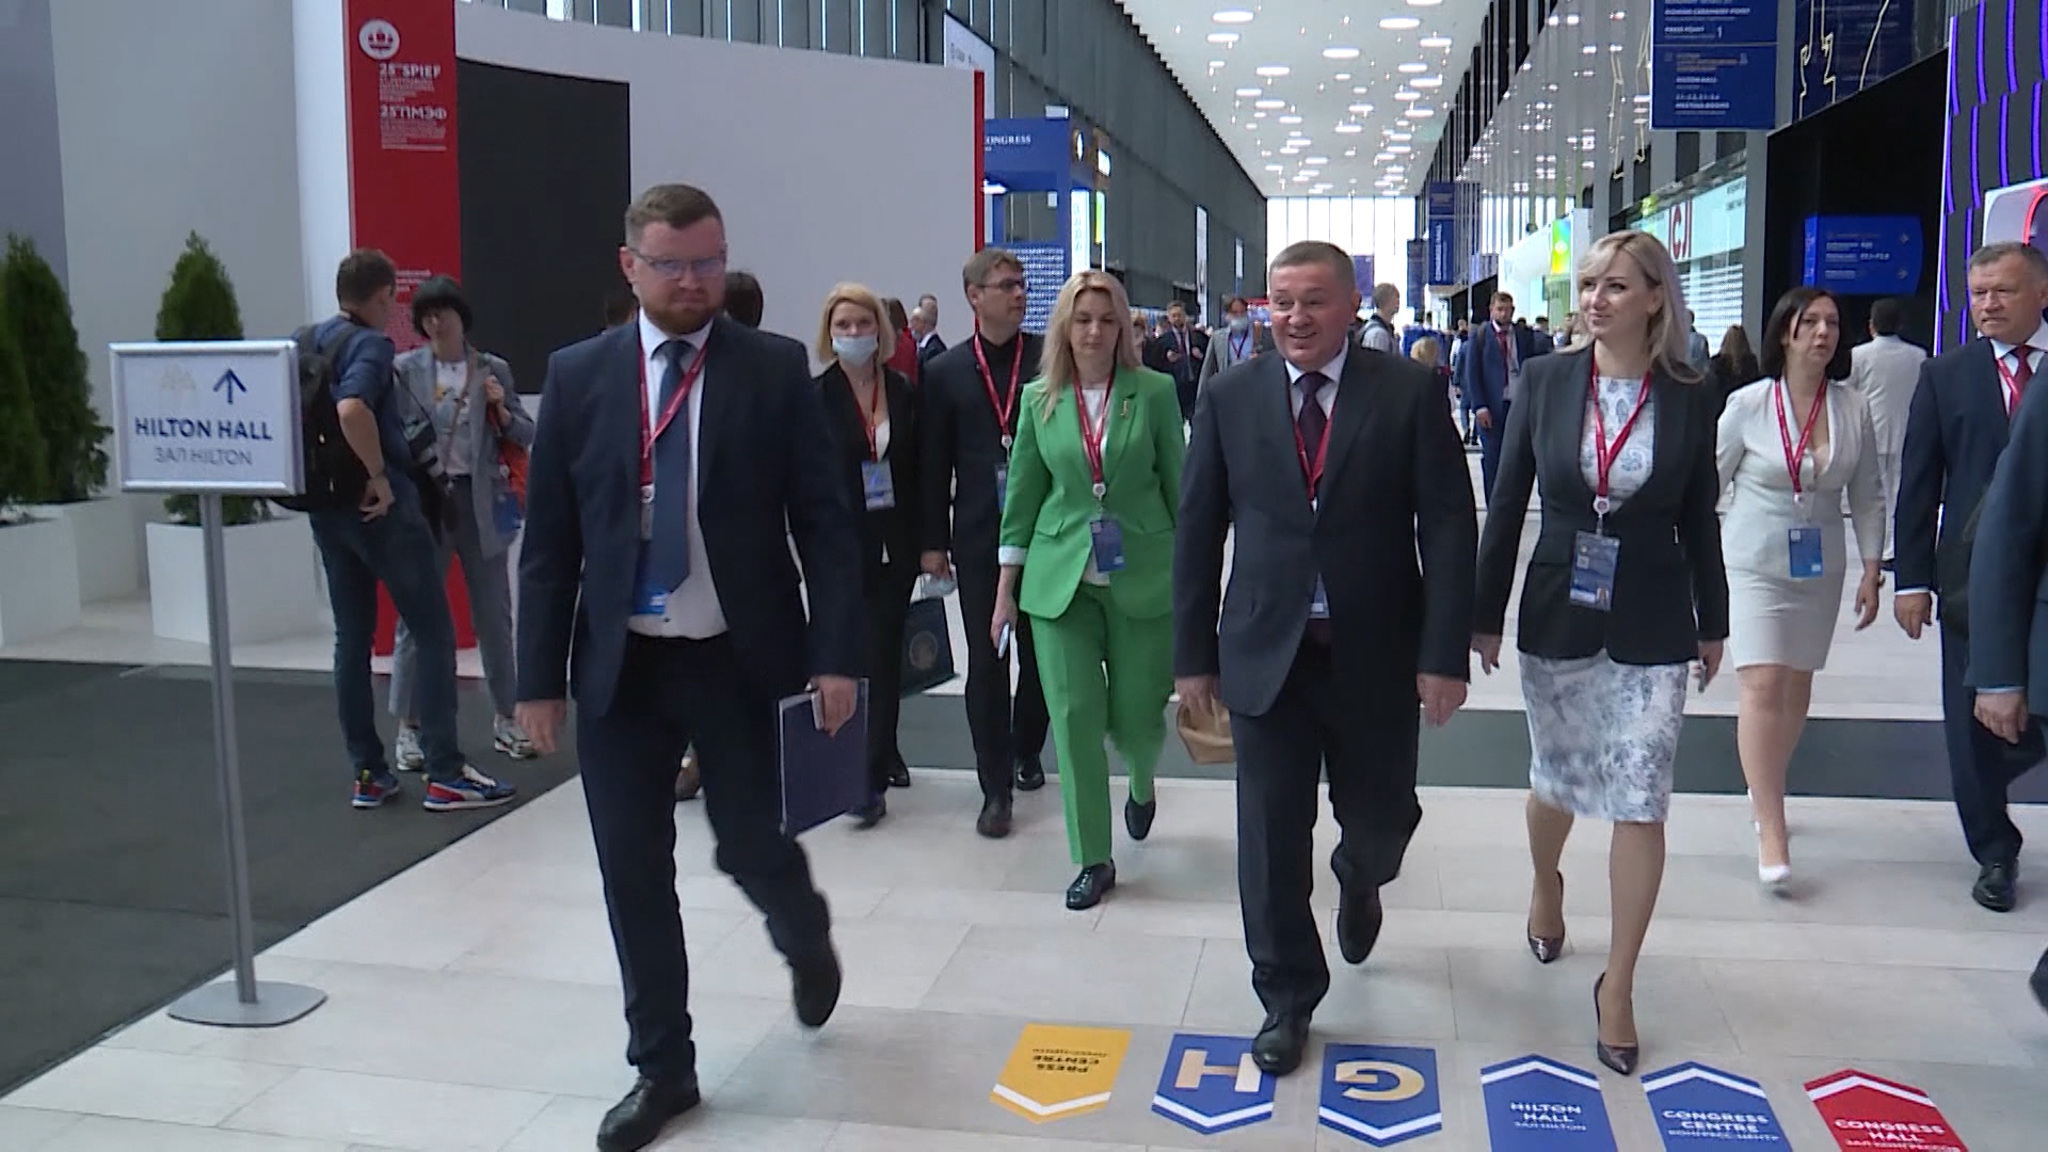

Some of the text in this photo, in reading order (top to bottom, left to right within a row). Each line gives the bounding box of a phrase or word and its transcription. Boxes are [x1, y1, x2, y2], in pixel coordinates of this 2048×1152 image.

[985, 135, 1031, 145] ONGRESS
[134, 417, 273, 441] HILTON HALL
[155, 446, 253, 466] ЗАЛ HILTON
[1174, 1049, 1264, 1093] H
[1510, 1102, 1582, 1114] HILTON
[1523, 1112, 1575, 1122] HALL
[1662, 1110, 1769, 1125] CONGRESS
[1681, 1121, 1759, 1133] CENTRE
[1834, 1119, 1946, 1135] CONGRESS
[1867, 1131, 1925, 1143] HALL
